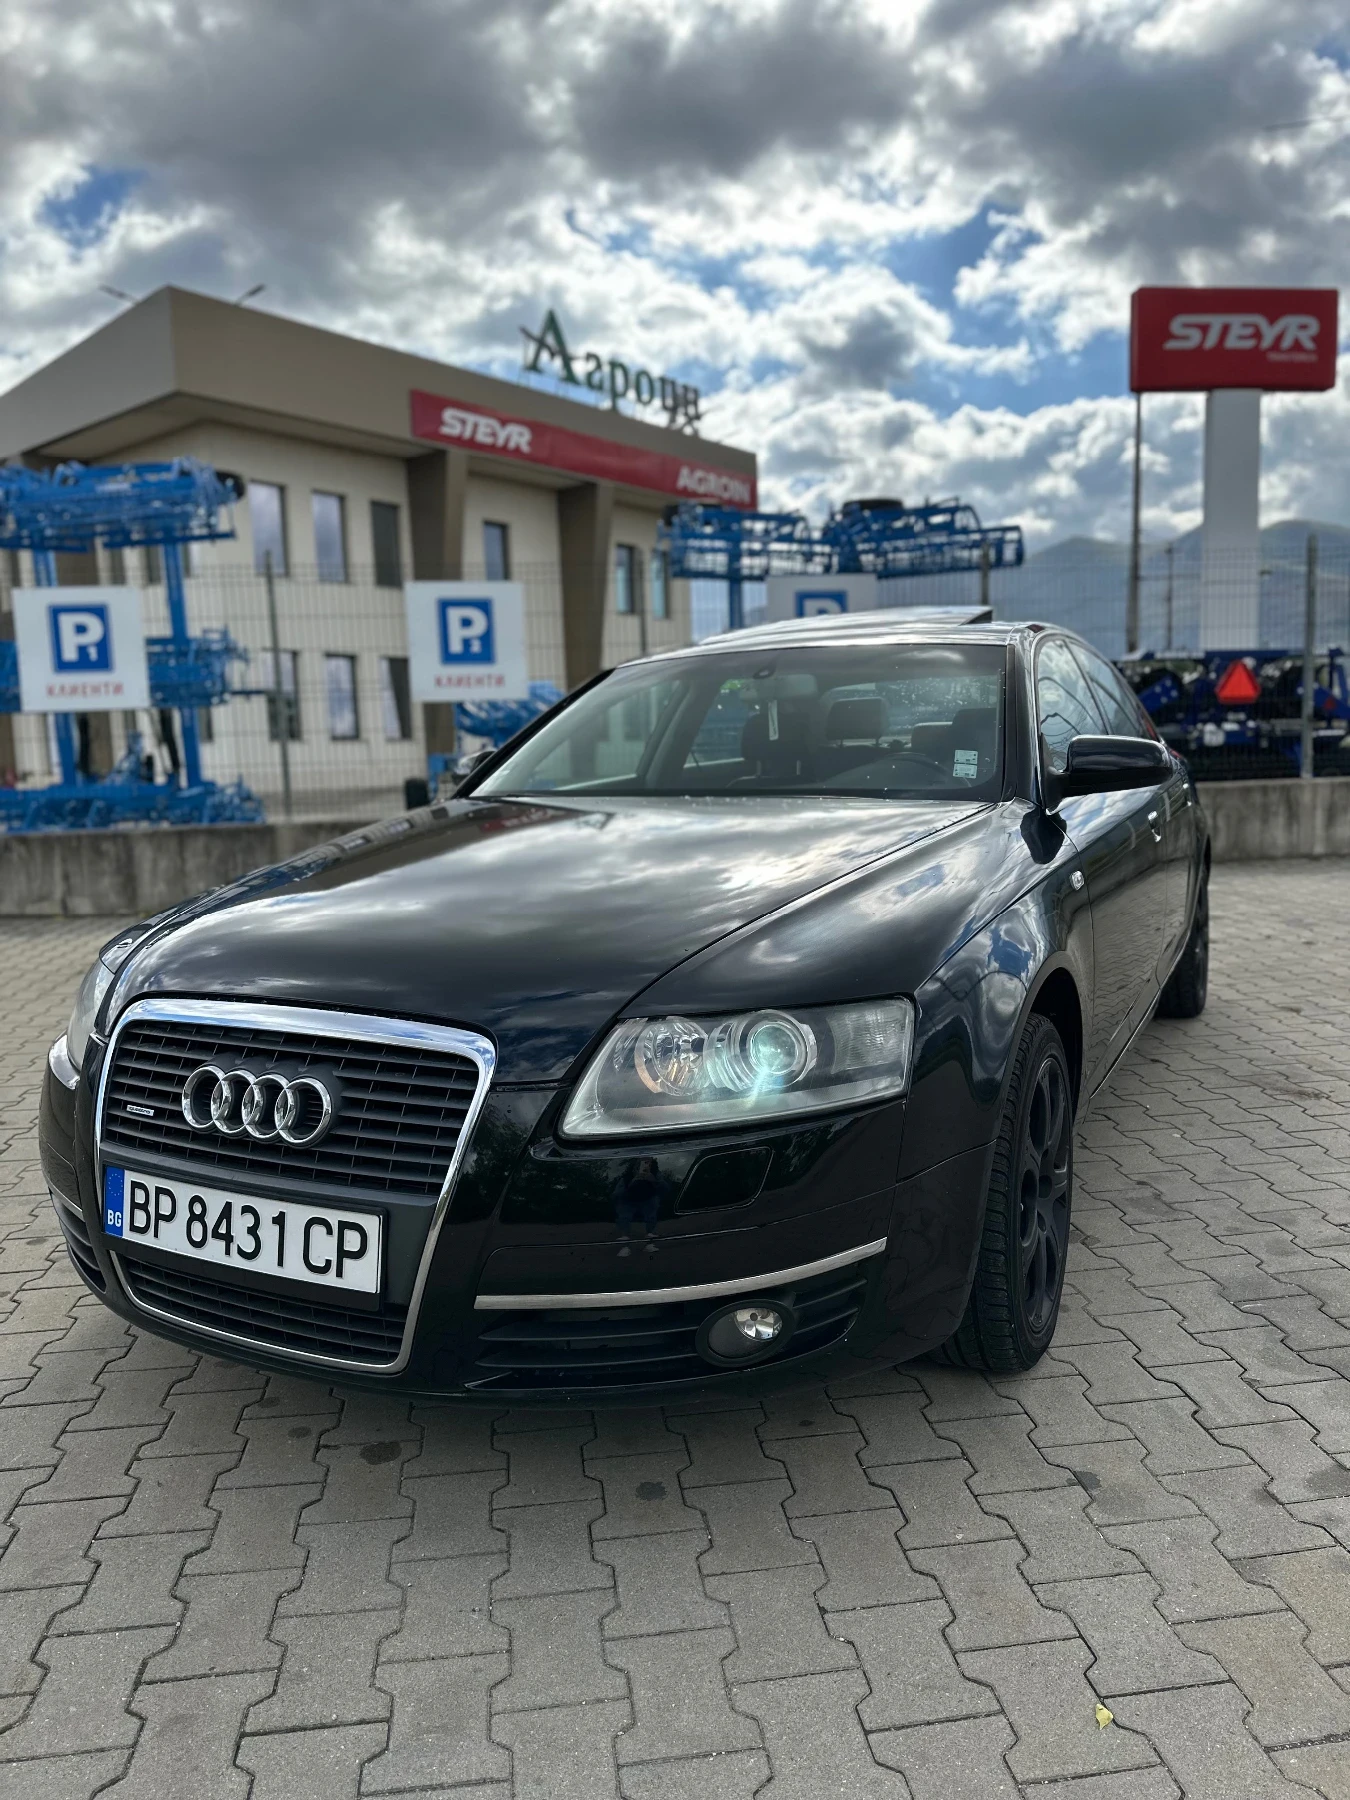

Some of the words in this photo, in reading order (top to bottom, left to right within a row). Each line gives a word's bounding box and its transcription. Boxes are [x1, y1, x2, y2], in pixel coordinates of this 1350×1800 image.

[1164, 314, 1320, 350] STEYR
[439, 406, 532, 453] STEYR
[107, 1209, 122, 1228] BG
[129, 1179, 177, 1239] BP
[186, 1194, 287, 1268] 8431
[302, 1216, 368, 1278] CP
